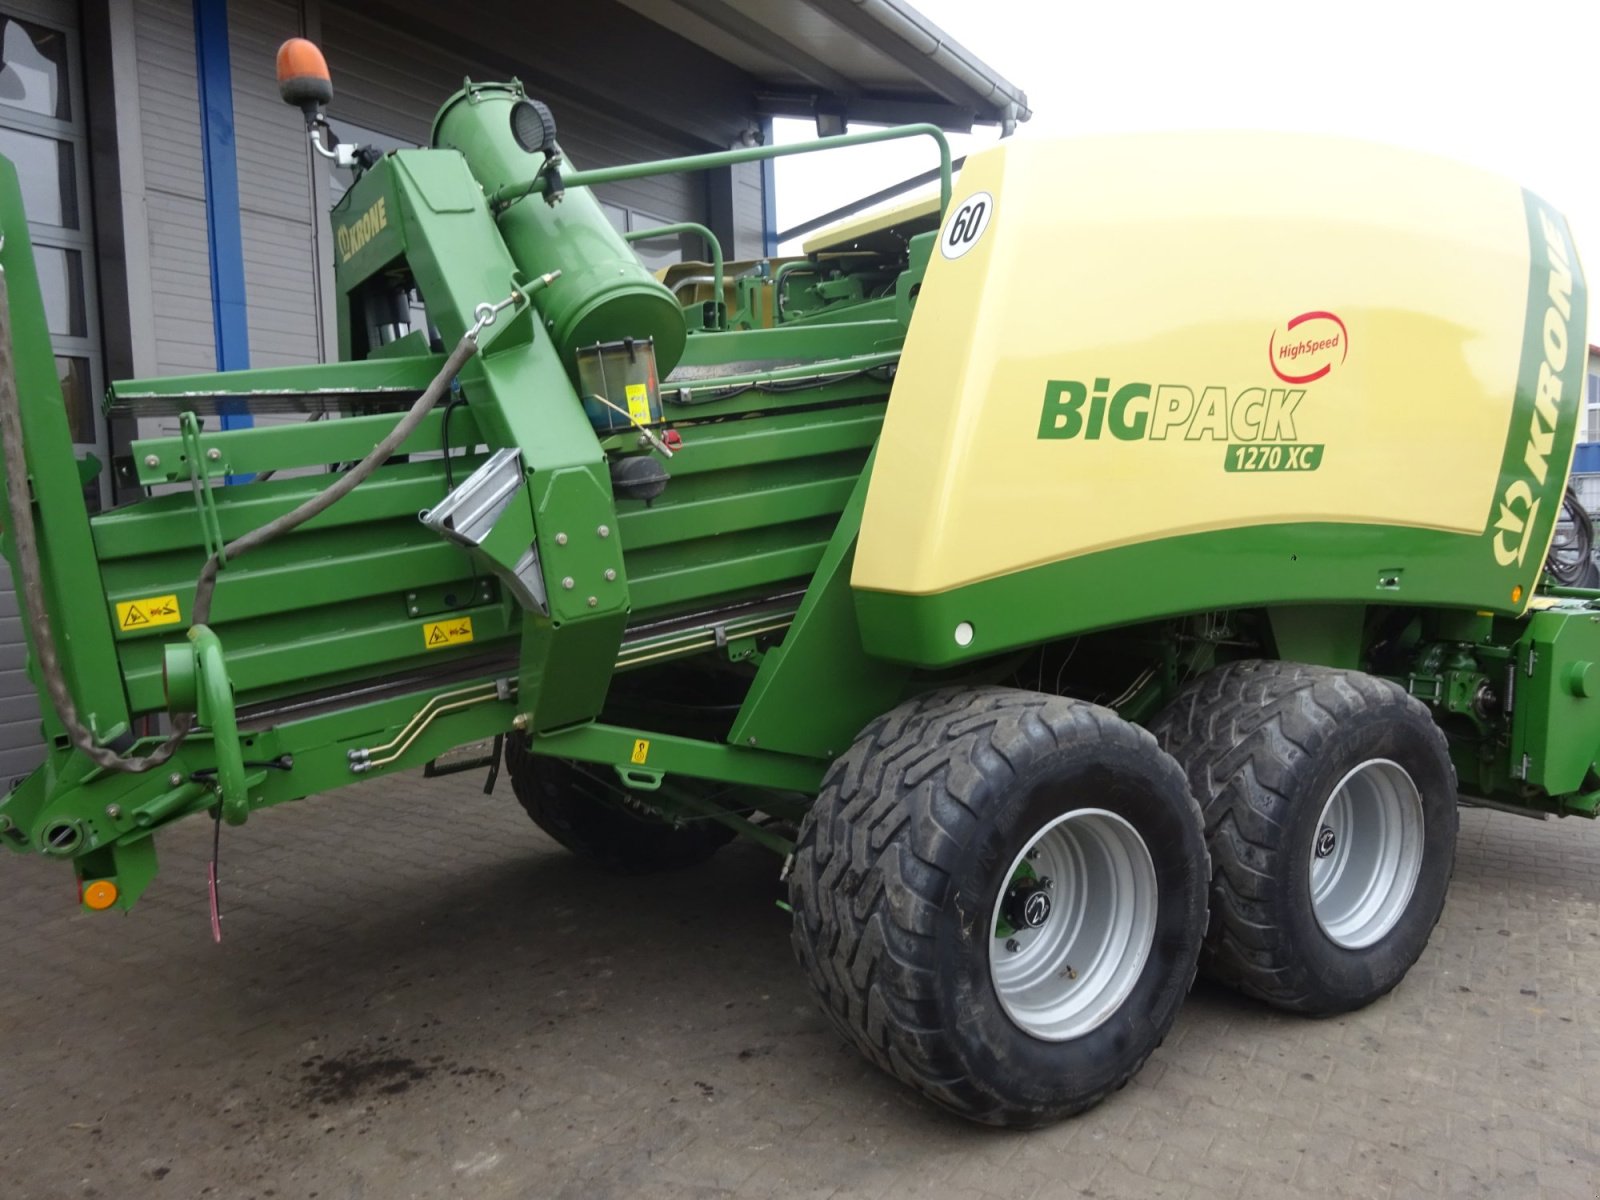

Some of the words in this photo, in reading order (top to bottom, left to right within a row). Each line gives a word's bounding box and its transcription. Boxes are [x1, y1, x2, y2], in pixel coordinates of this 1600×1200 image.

[349, 196, 387, 255] KRONE
[949, 202, 985, 246] 60
[1279, 334, 1339, 360] HighSpeed
[1524, 207, 1572, 485] KRONE
[1235, 446, 1281, 470] 1270
[1284, 447, 1315, 469] XC
